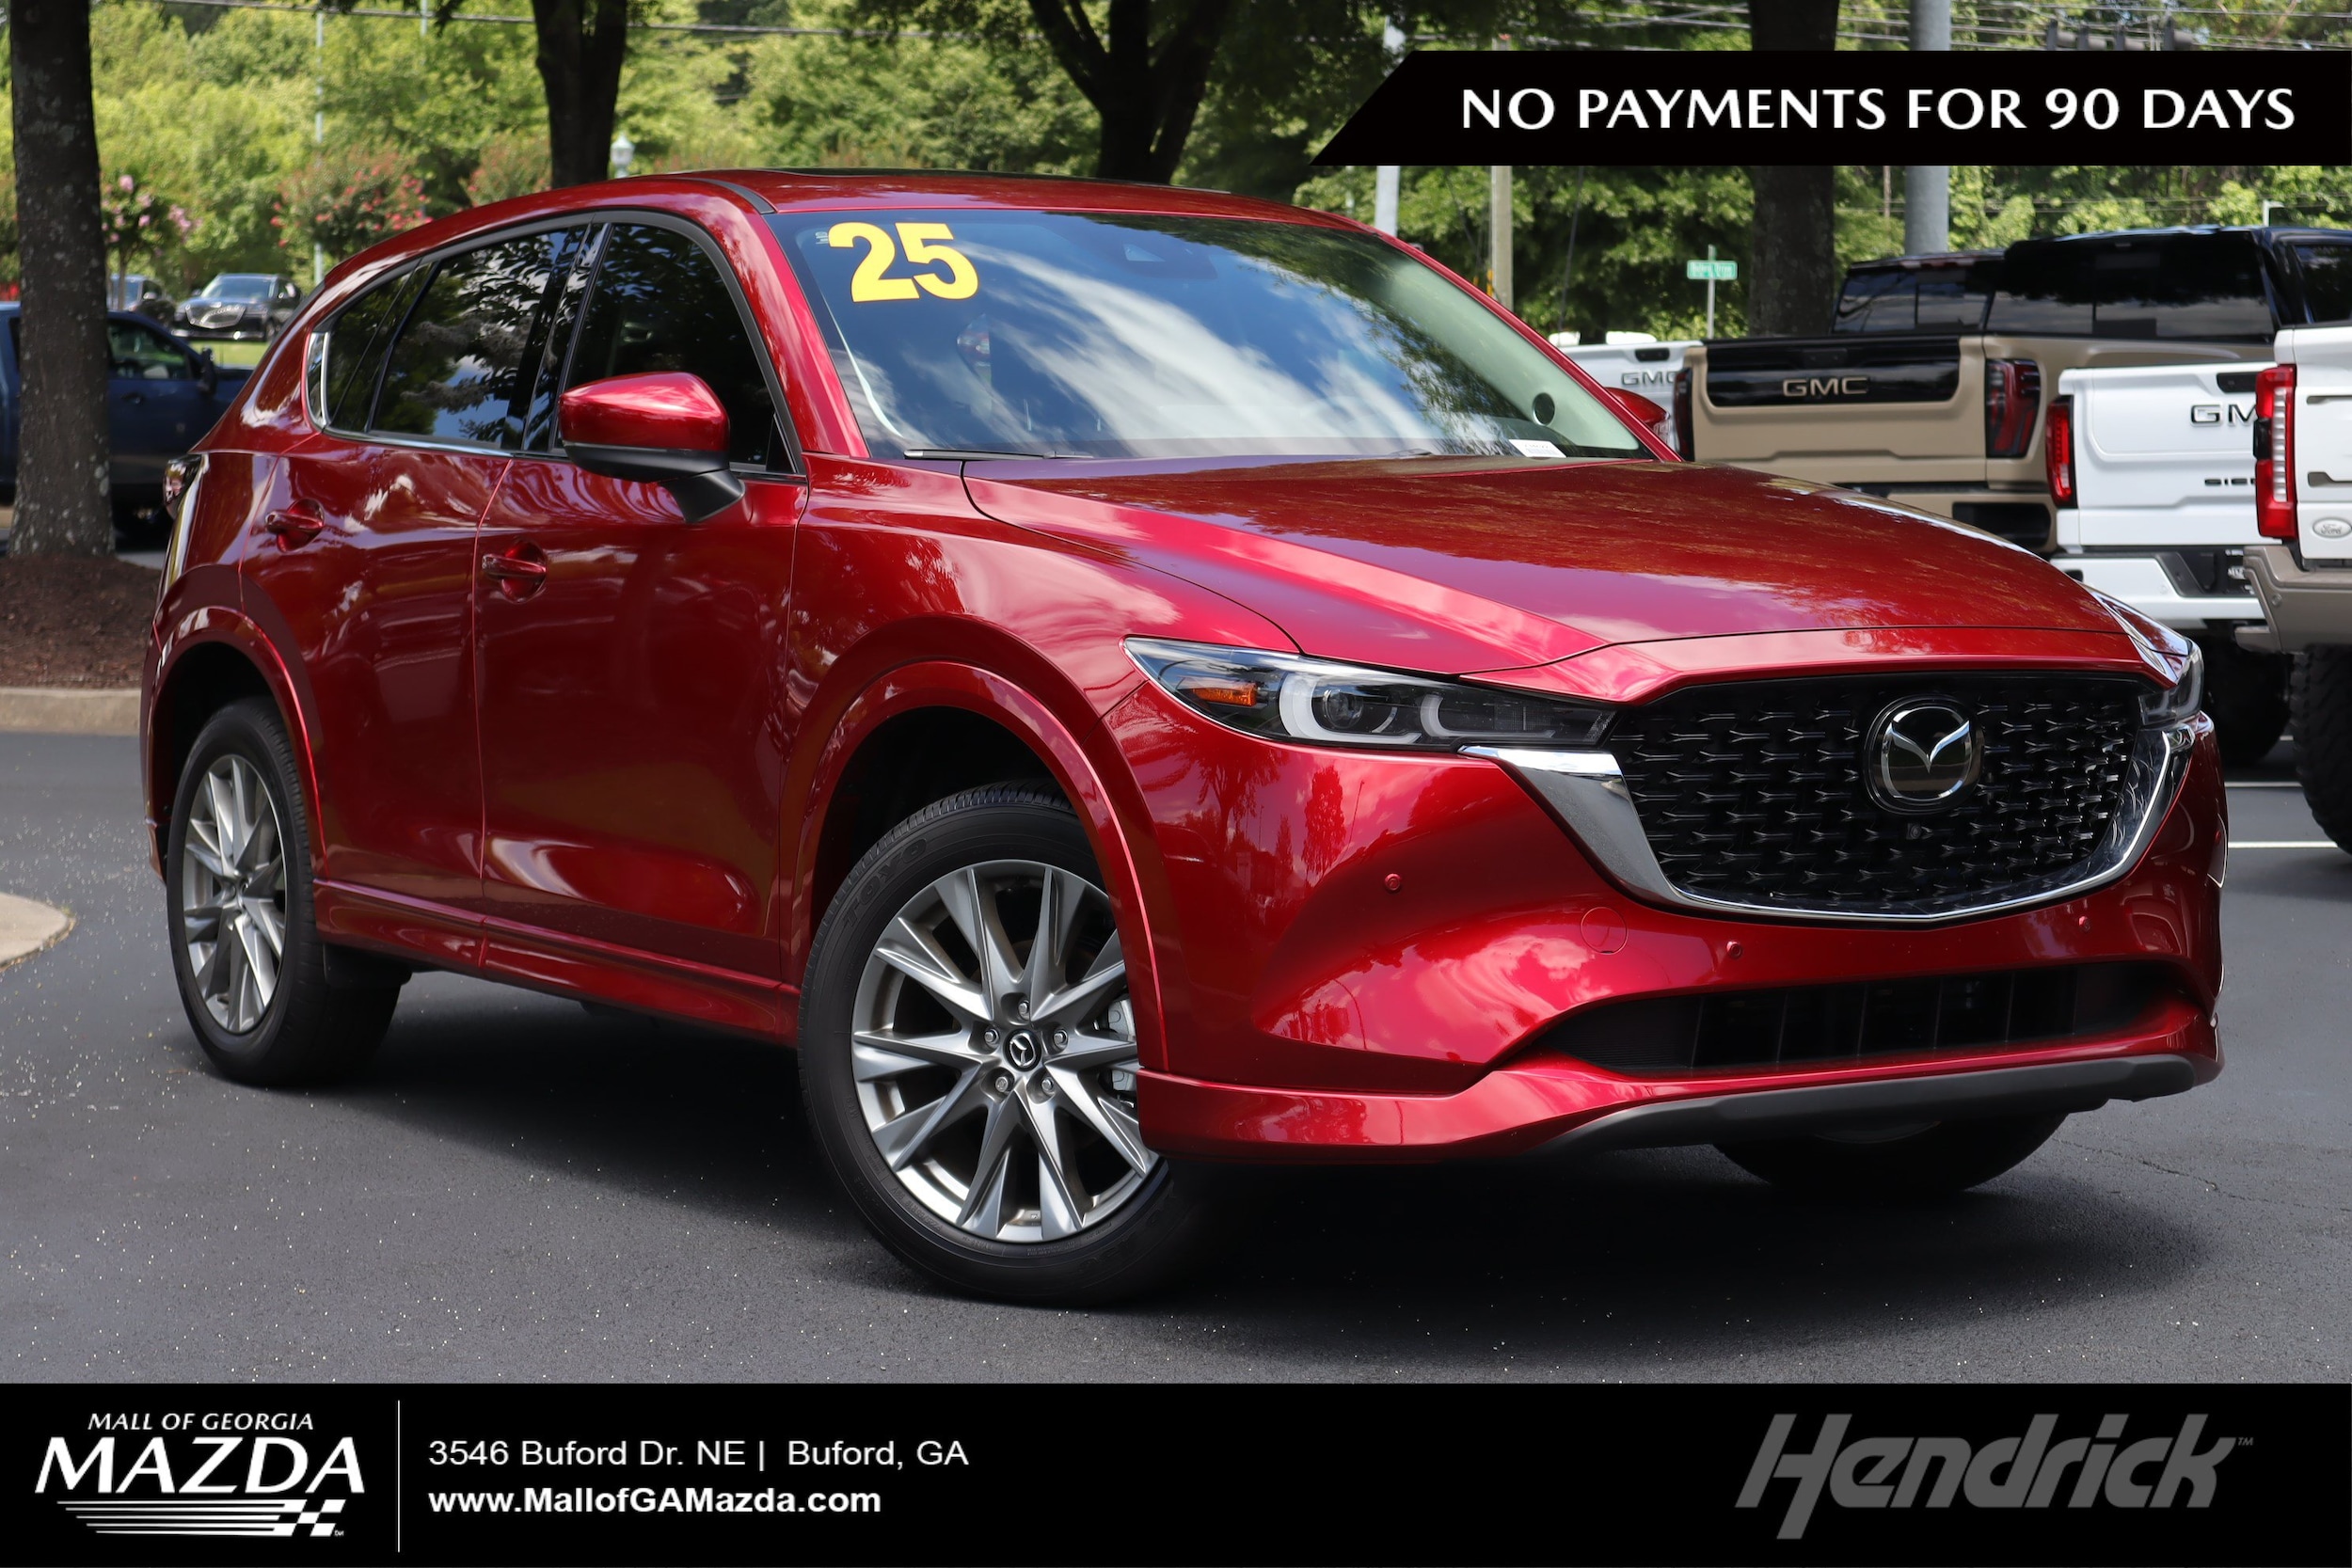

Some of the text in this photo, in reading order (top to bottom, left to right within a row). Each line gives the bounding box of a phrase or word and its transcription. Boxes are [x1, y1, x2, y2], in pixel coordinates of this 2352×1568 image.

[828, 221, 979, 303] 25
[1782, 376, 1868, 397] GMC
[844, 837, 928, 927] TOYO
